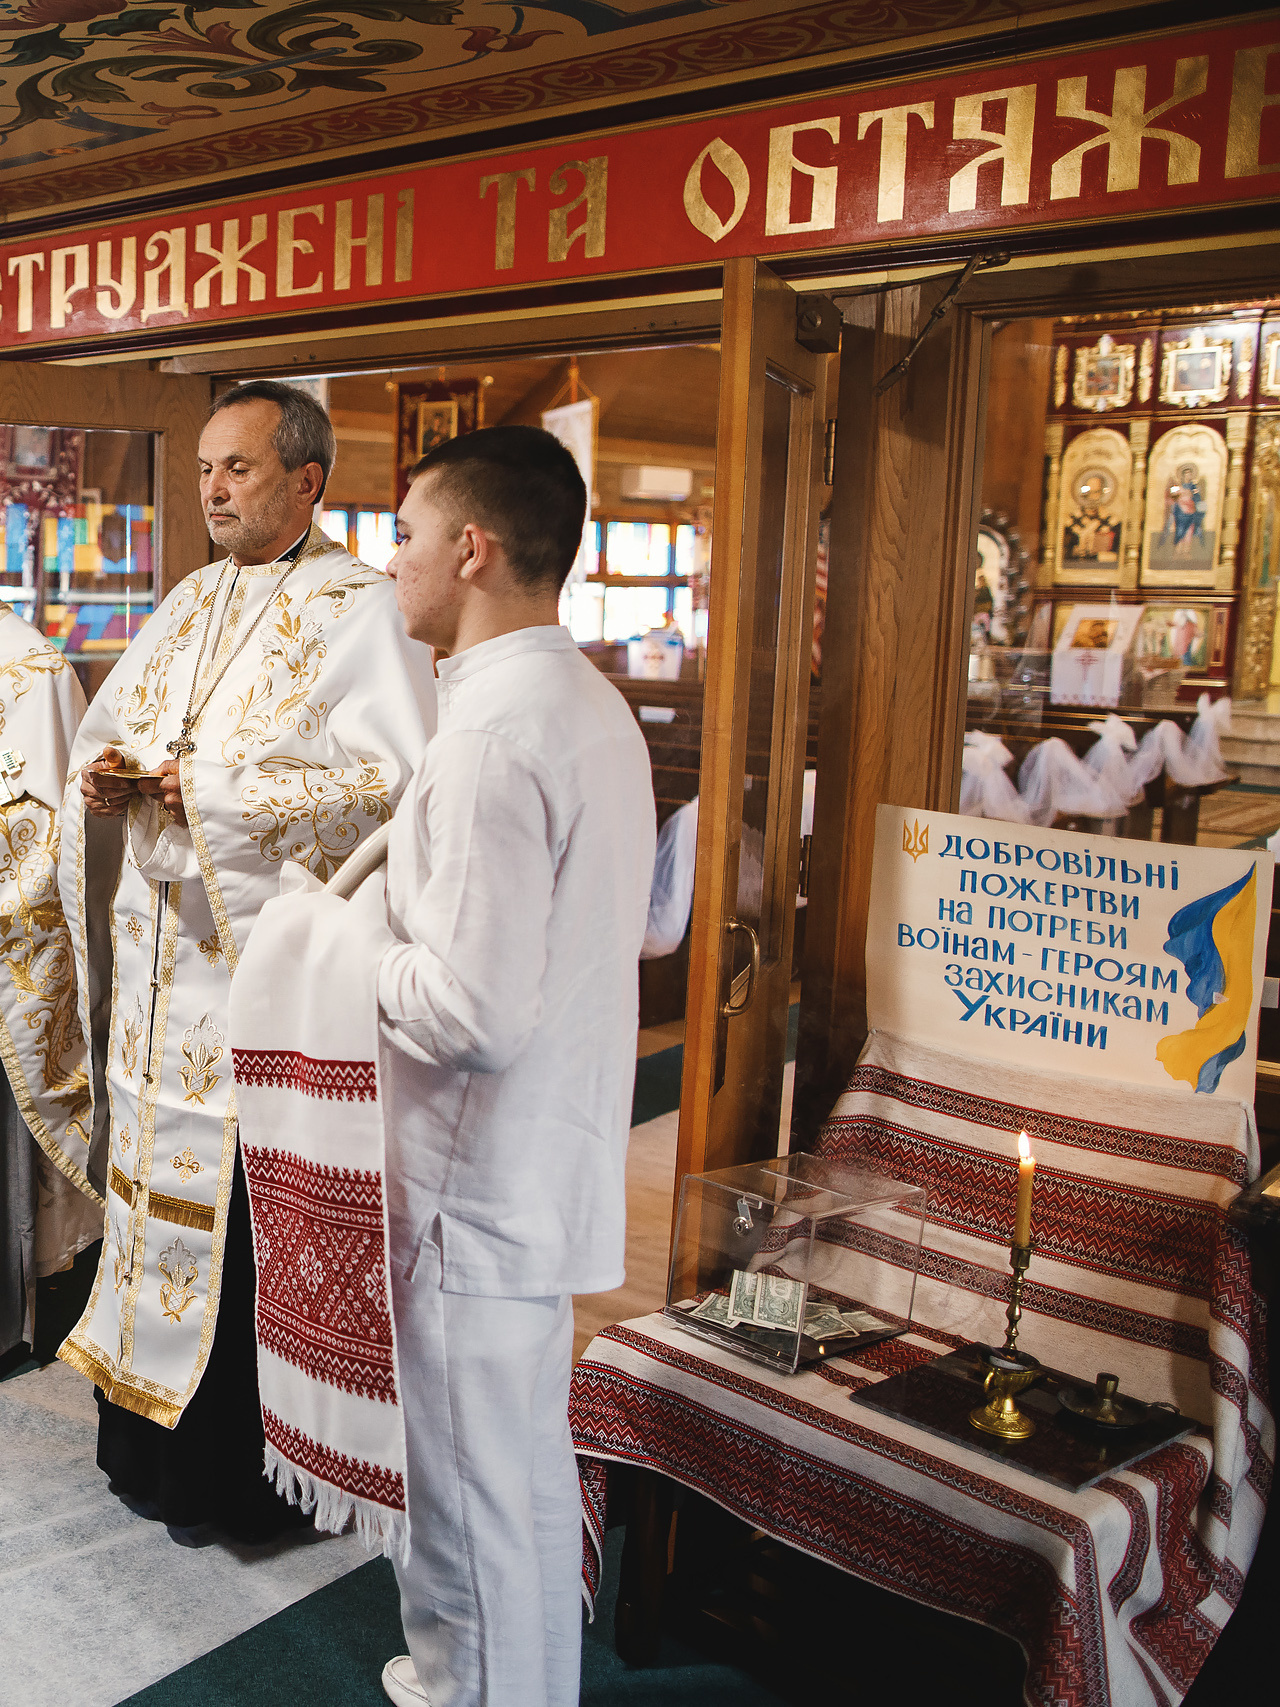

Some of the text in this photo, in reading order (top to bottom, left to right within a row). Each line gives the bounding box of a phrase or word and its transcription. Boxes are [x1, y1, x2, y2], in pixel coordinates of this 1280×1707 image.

[479, 155, 610, 272] ТА
[959, 869, 1140, 920] ПОЖЕРТВИ
[988, 905, 1128, 950] ПОТРЕБИ
[1041, 947, 1178, 994] ГЕРОЯМ
